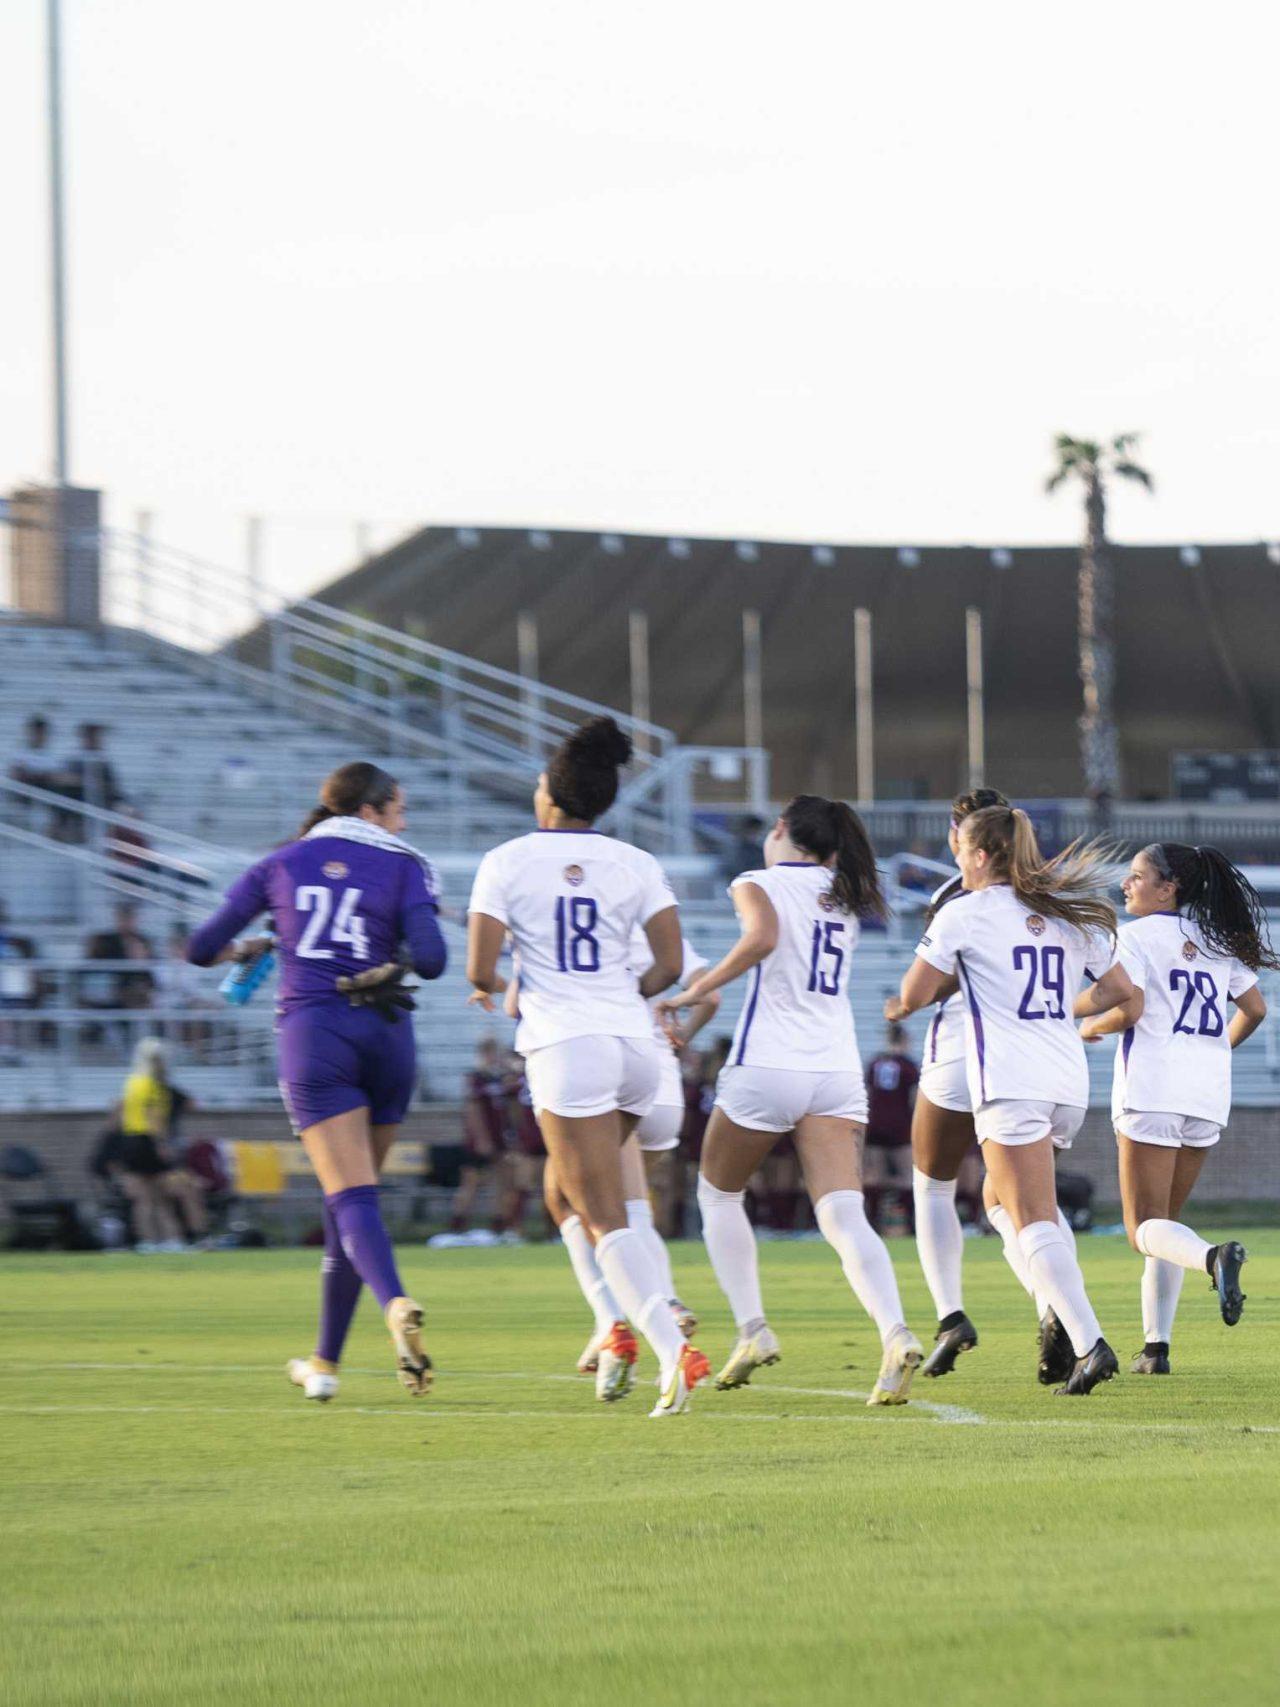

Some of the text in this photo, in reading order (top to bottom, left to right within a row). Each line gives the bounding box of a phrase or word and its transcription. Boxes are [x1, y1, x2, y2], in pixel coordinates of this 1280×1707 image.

[295, 885, 370, 959] 24
[555, 896, 600, 972] 18
[808, 920, 845, 996] 15
[1013, 945, 1065, 1020] 29
[1169, 969, 1223, 1037] 28
